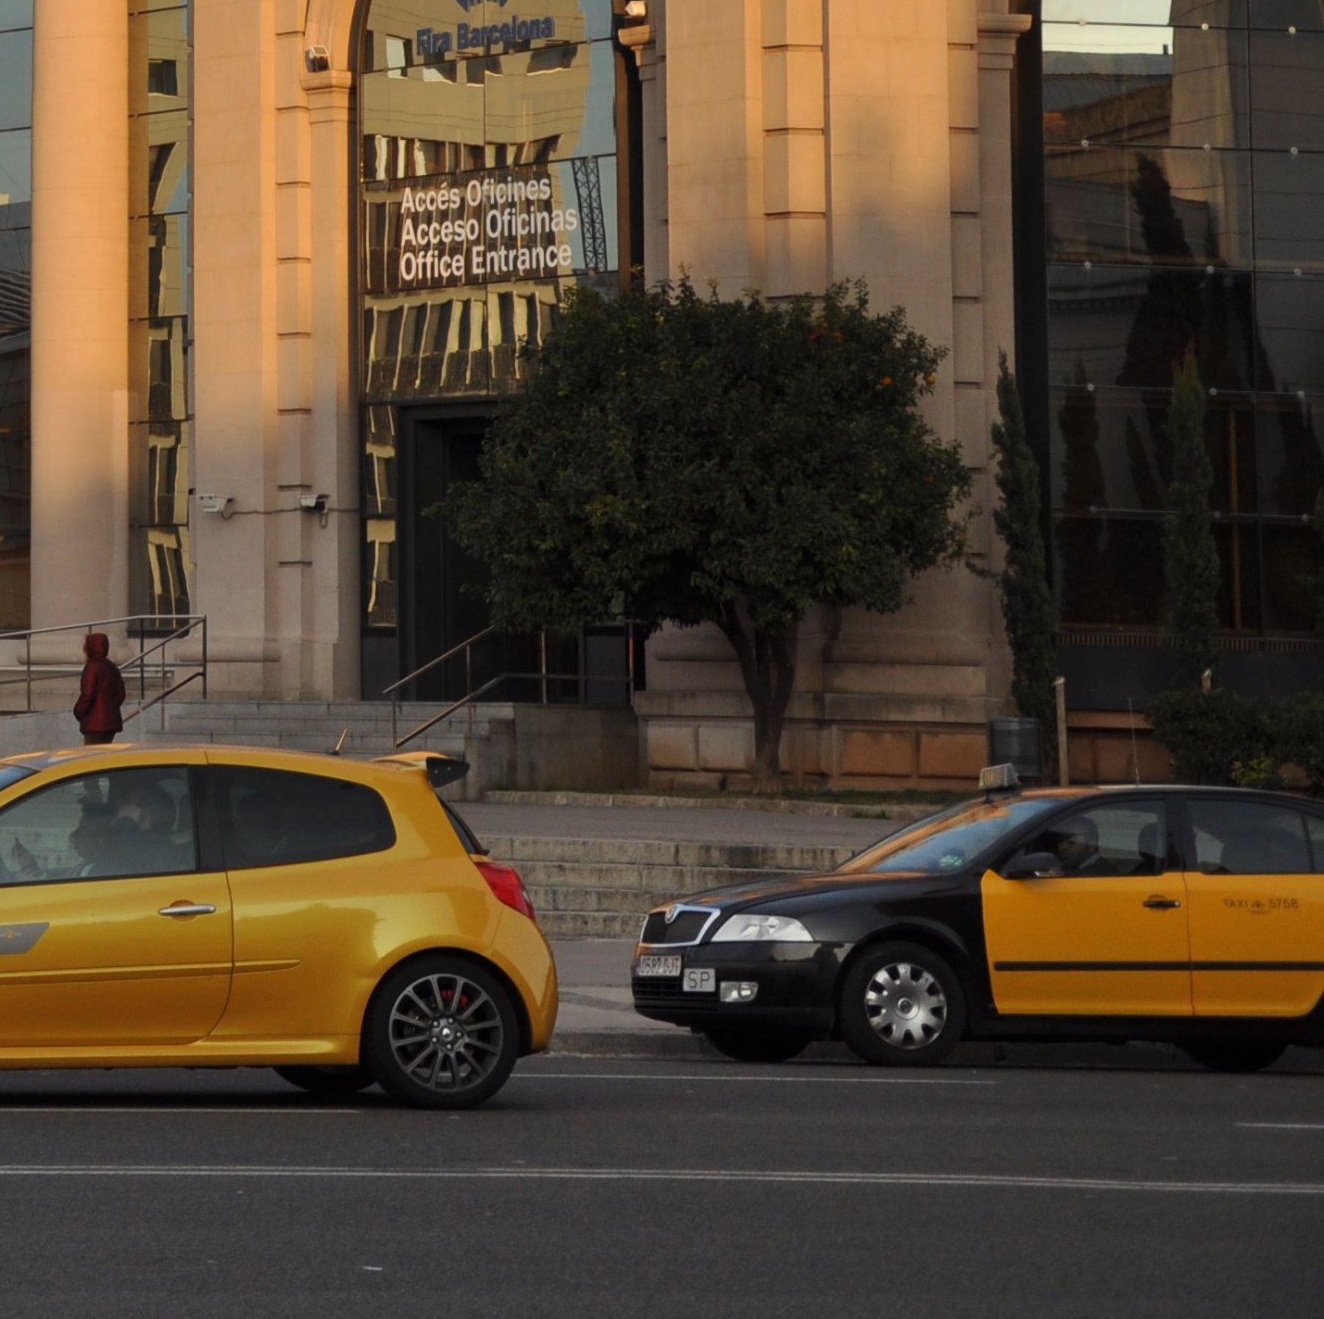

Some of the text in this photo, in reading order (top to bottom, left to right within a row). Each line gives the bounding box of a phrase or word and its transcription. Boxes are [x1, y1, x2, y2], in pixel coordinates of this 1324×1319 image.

[416, 15, 555, 56] Fira Barcelona
[401, 176, 551, 214] Accés Oficines
[401, 206, 578, 247] Acceso Oficinas
[401, 243, 572, 281] Office Entrance
[1223, 898, 1248, 909] TAXI
[688, 971, 711, 989] SP
